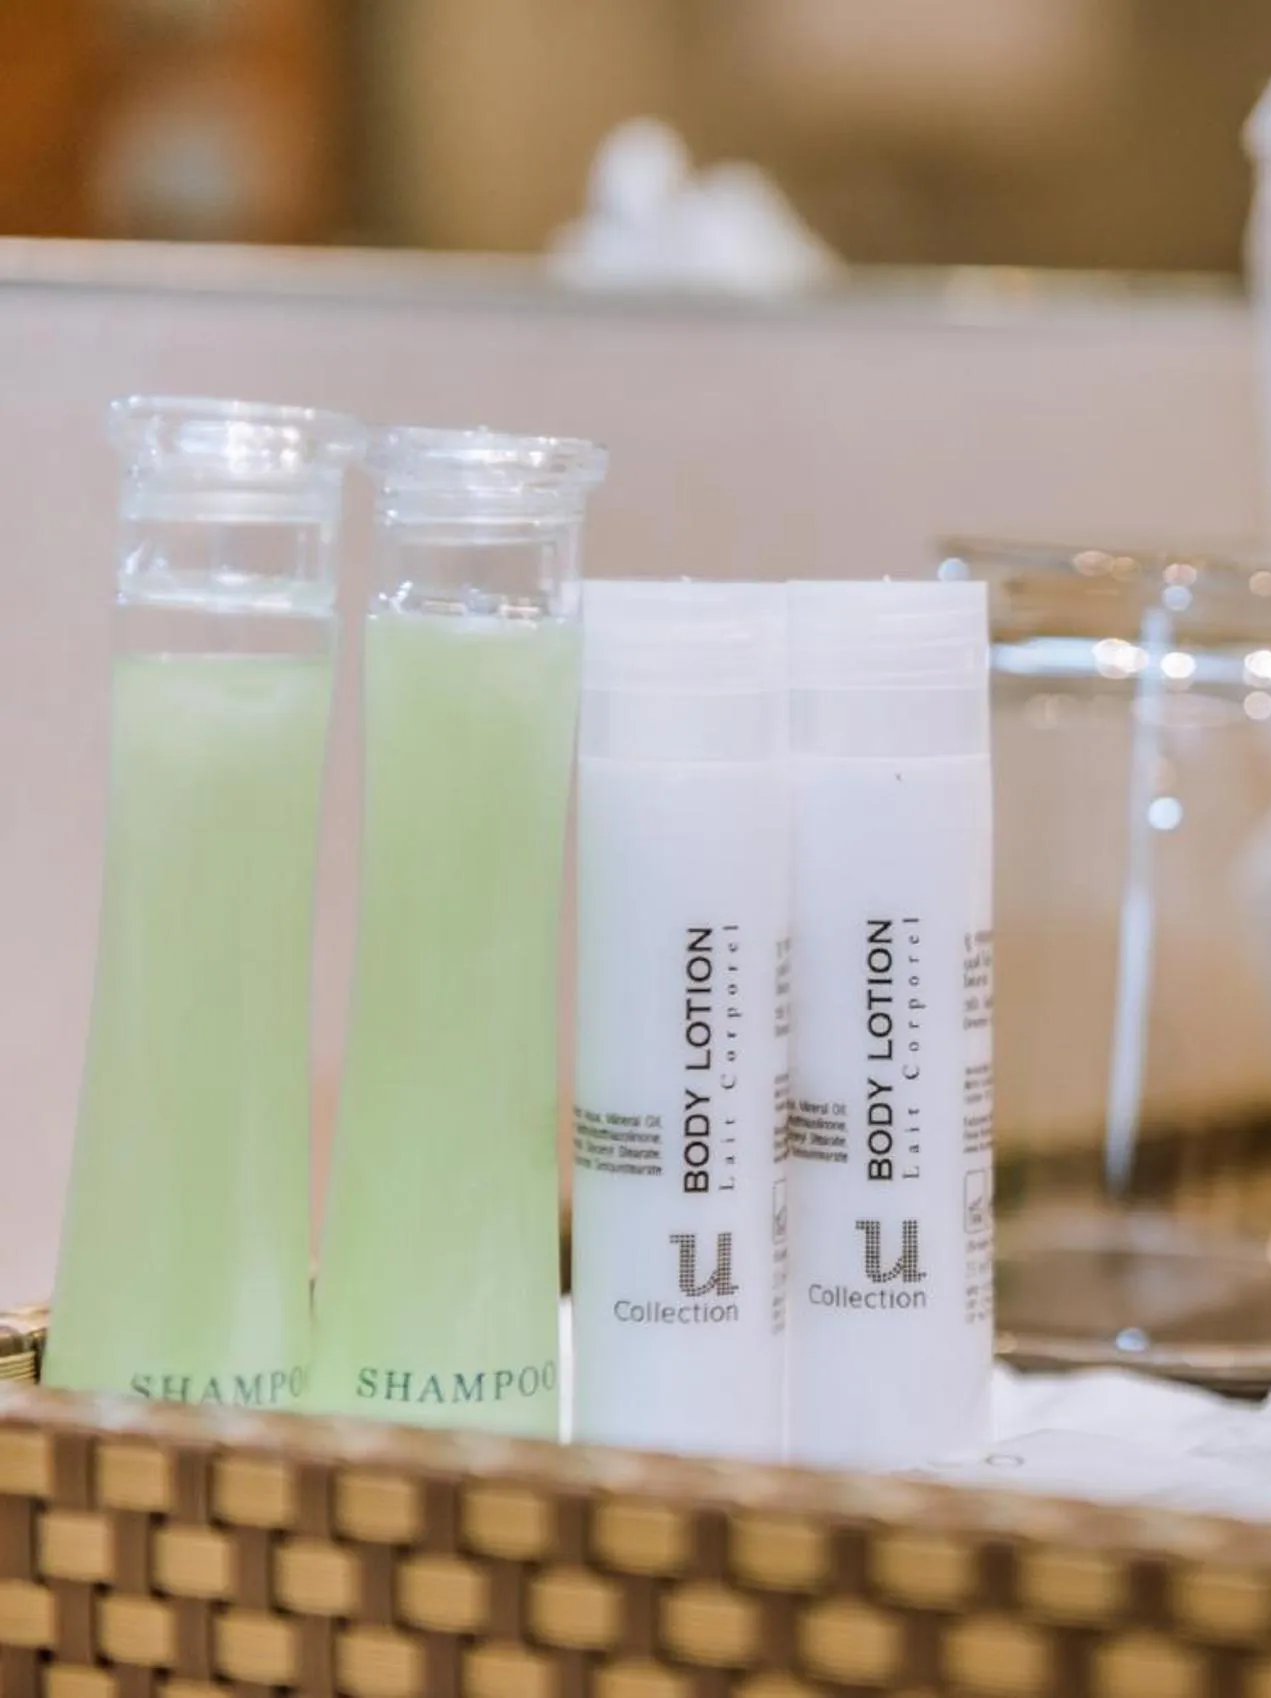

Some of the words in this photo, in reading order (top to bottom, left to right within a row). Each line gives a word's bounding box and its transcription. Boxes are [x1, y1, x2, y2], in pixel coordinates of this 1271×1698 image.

[685, 927, 712, 1071] LOTION
[720, 924, 742, 1090] Corporel
[867, 919, 893, 1061] LOTION
[902, 917, 926, 1080] Corporel
[684, 1088, 711, 1194] BODY
[719, 1118, 736, 1191] Lait
[868, 1078, 893, 1181] BODY
[902, 1107, 920, 1179] Lait
[613, 1300, 739, 1325] Collection
[807, 1284, 926, 1310] Collection
[355, 1360, 557, 1404] SHAMPOO
